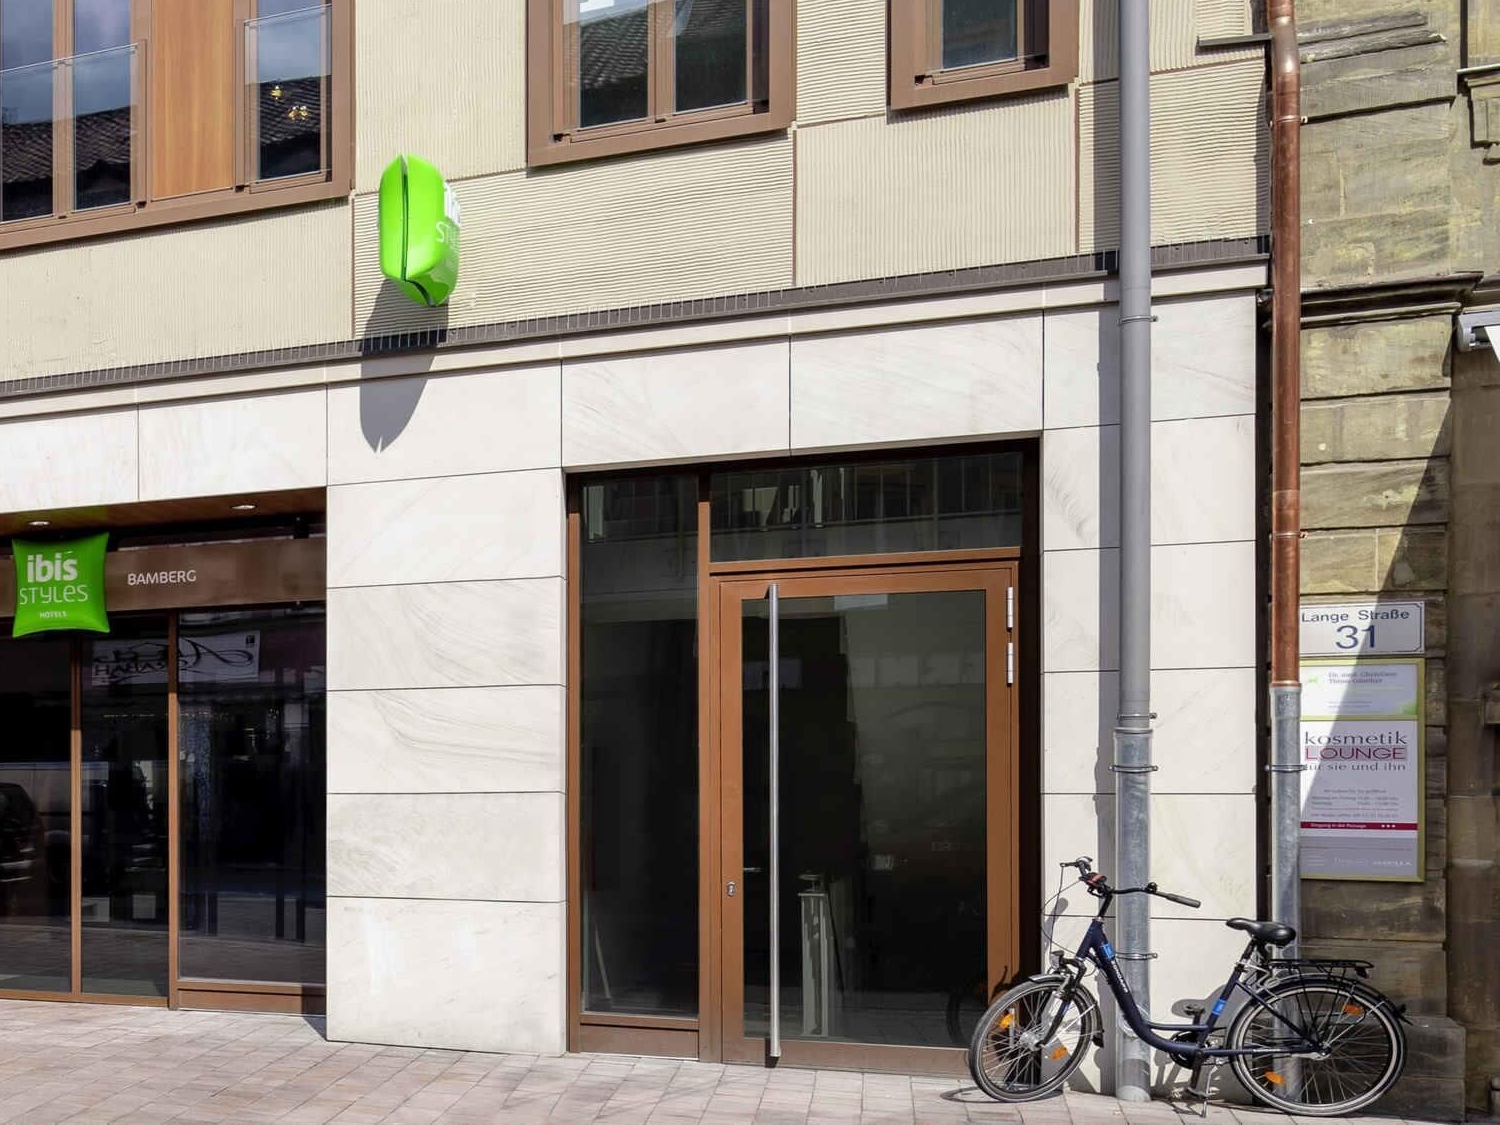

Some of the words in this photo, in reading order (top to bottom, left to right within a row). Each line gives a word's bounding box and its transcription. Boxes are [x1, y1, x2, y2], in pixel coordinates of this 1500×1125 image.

[27, 552, 78, 583] ibis
[127, 569, 197, 586] BAMBERG
[39, 611, 68, 619] HOTELS
[1301, 612, 1349, 624] Lange
[1358, 609, 1410, 621] Straße
[1335, 624, 1376, 649] 31
[1305, 731, 1407, 745] kosmetik
[1305, 747, 1406, 760] LOUNGE
[1327, 762, 1347, 771] sie
[1351, 762, 1378, 771] und
[1384, 762, 1406, 771] ihn
